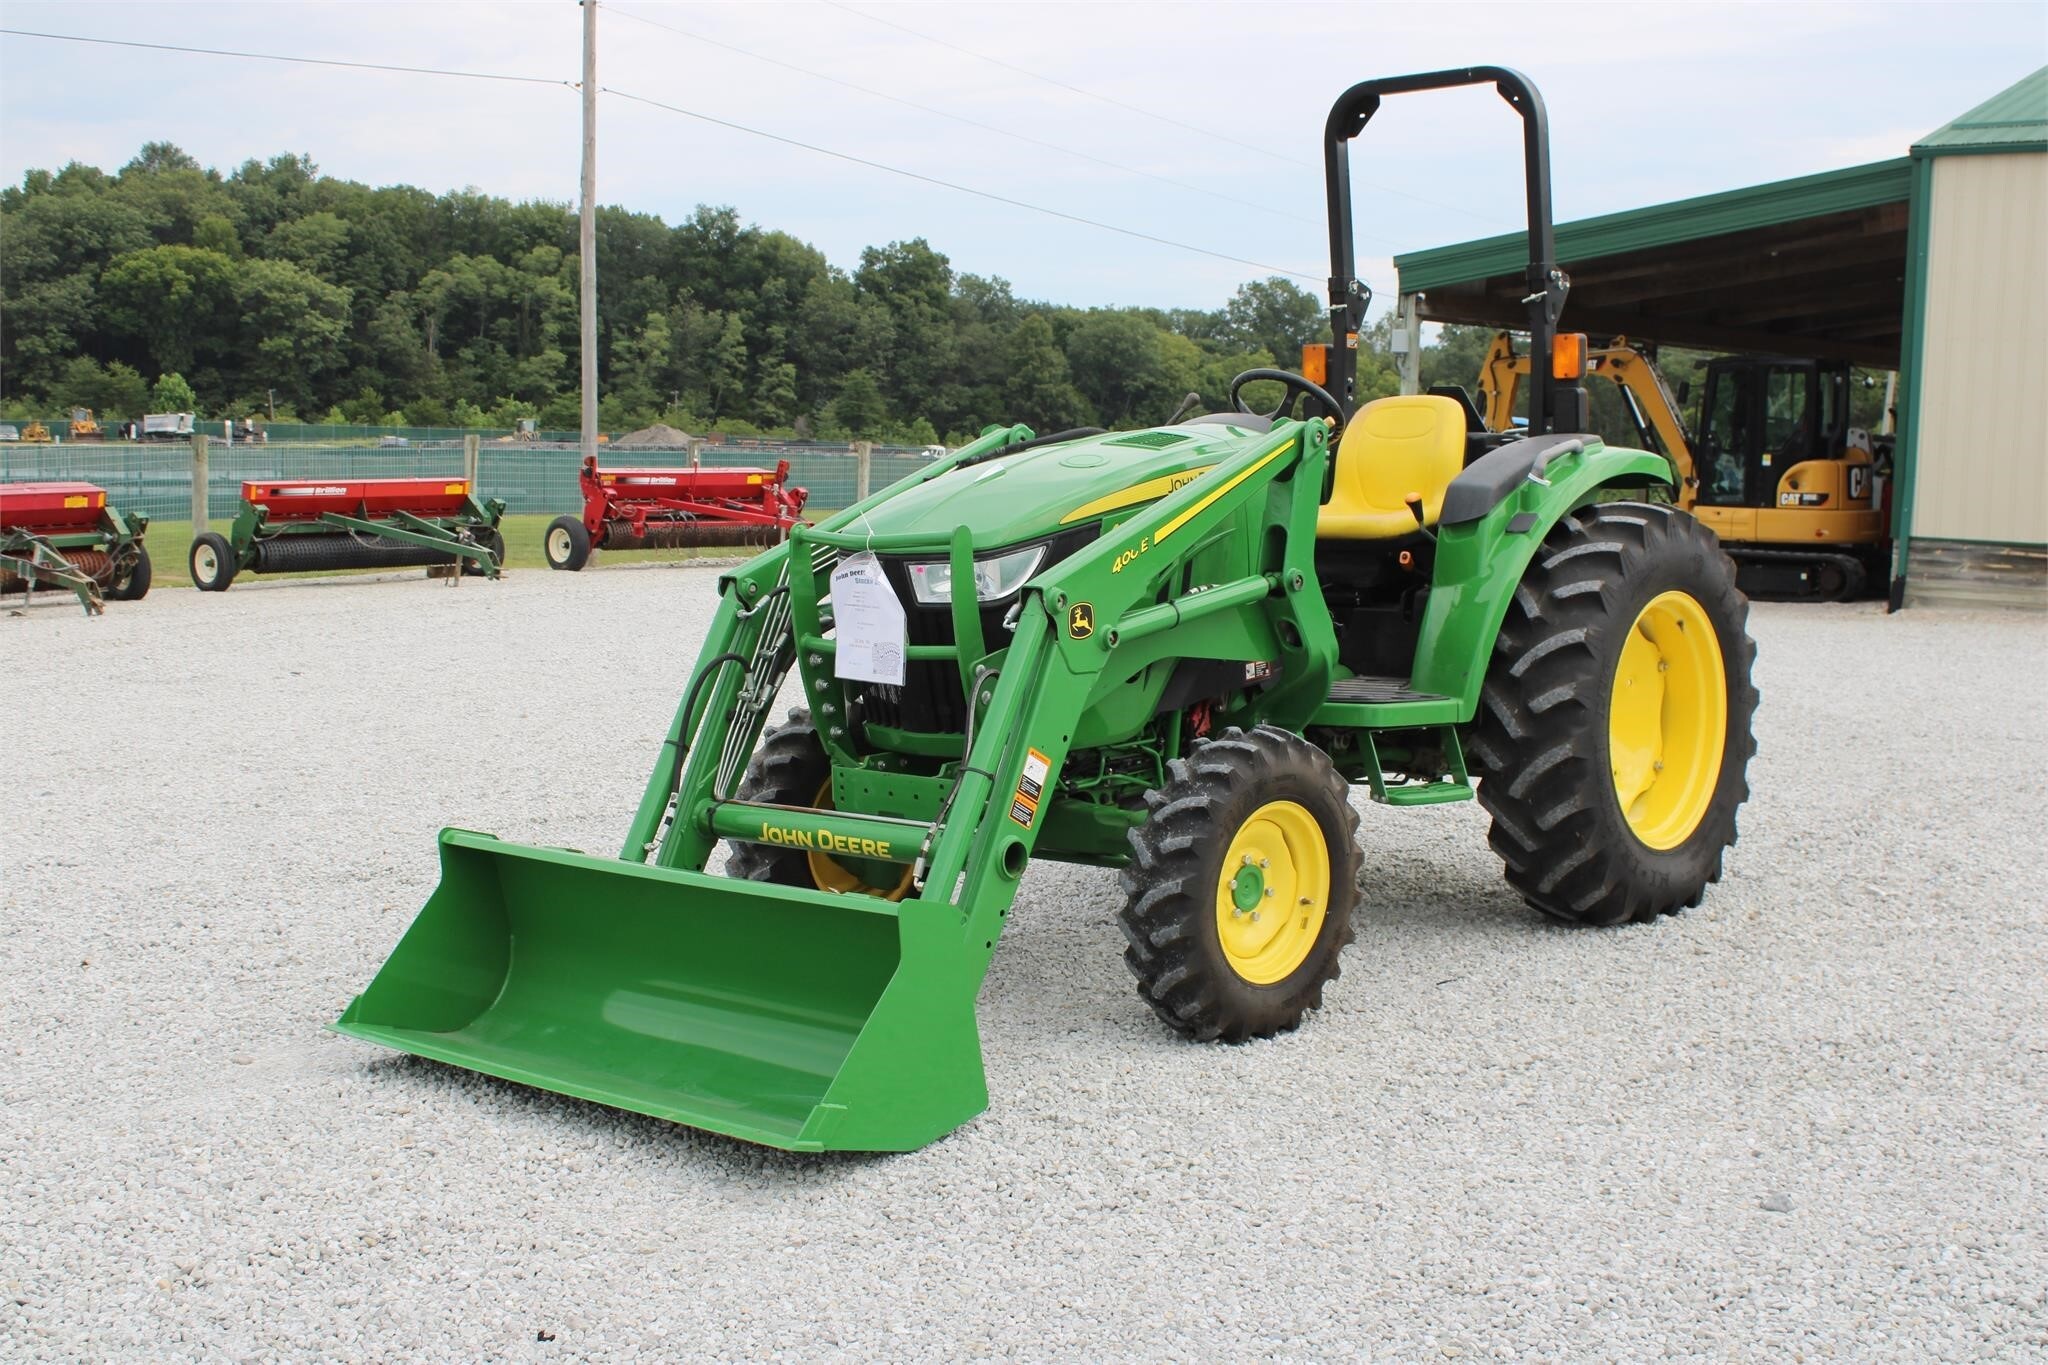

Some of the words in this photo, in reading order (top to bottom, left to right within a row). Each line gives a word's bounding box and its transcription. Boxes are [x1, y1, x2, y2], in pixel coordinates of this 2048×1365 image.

[315, 486, 347, 496] Brillion
[1781, 493, 1801, 505] CAT
[758, 822, 815, 848] JOHN
[817, 828, 892, 859] DEERE
